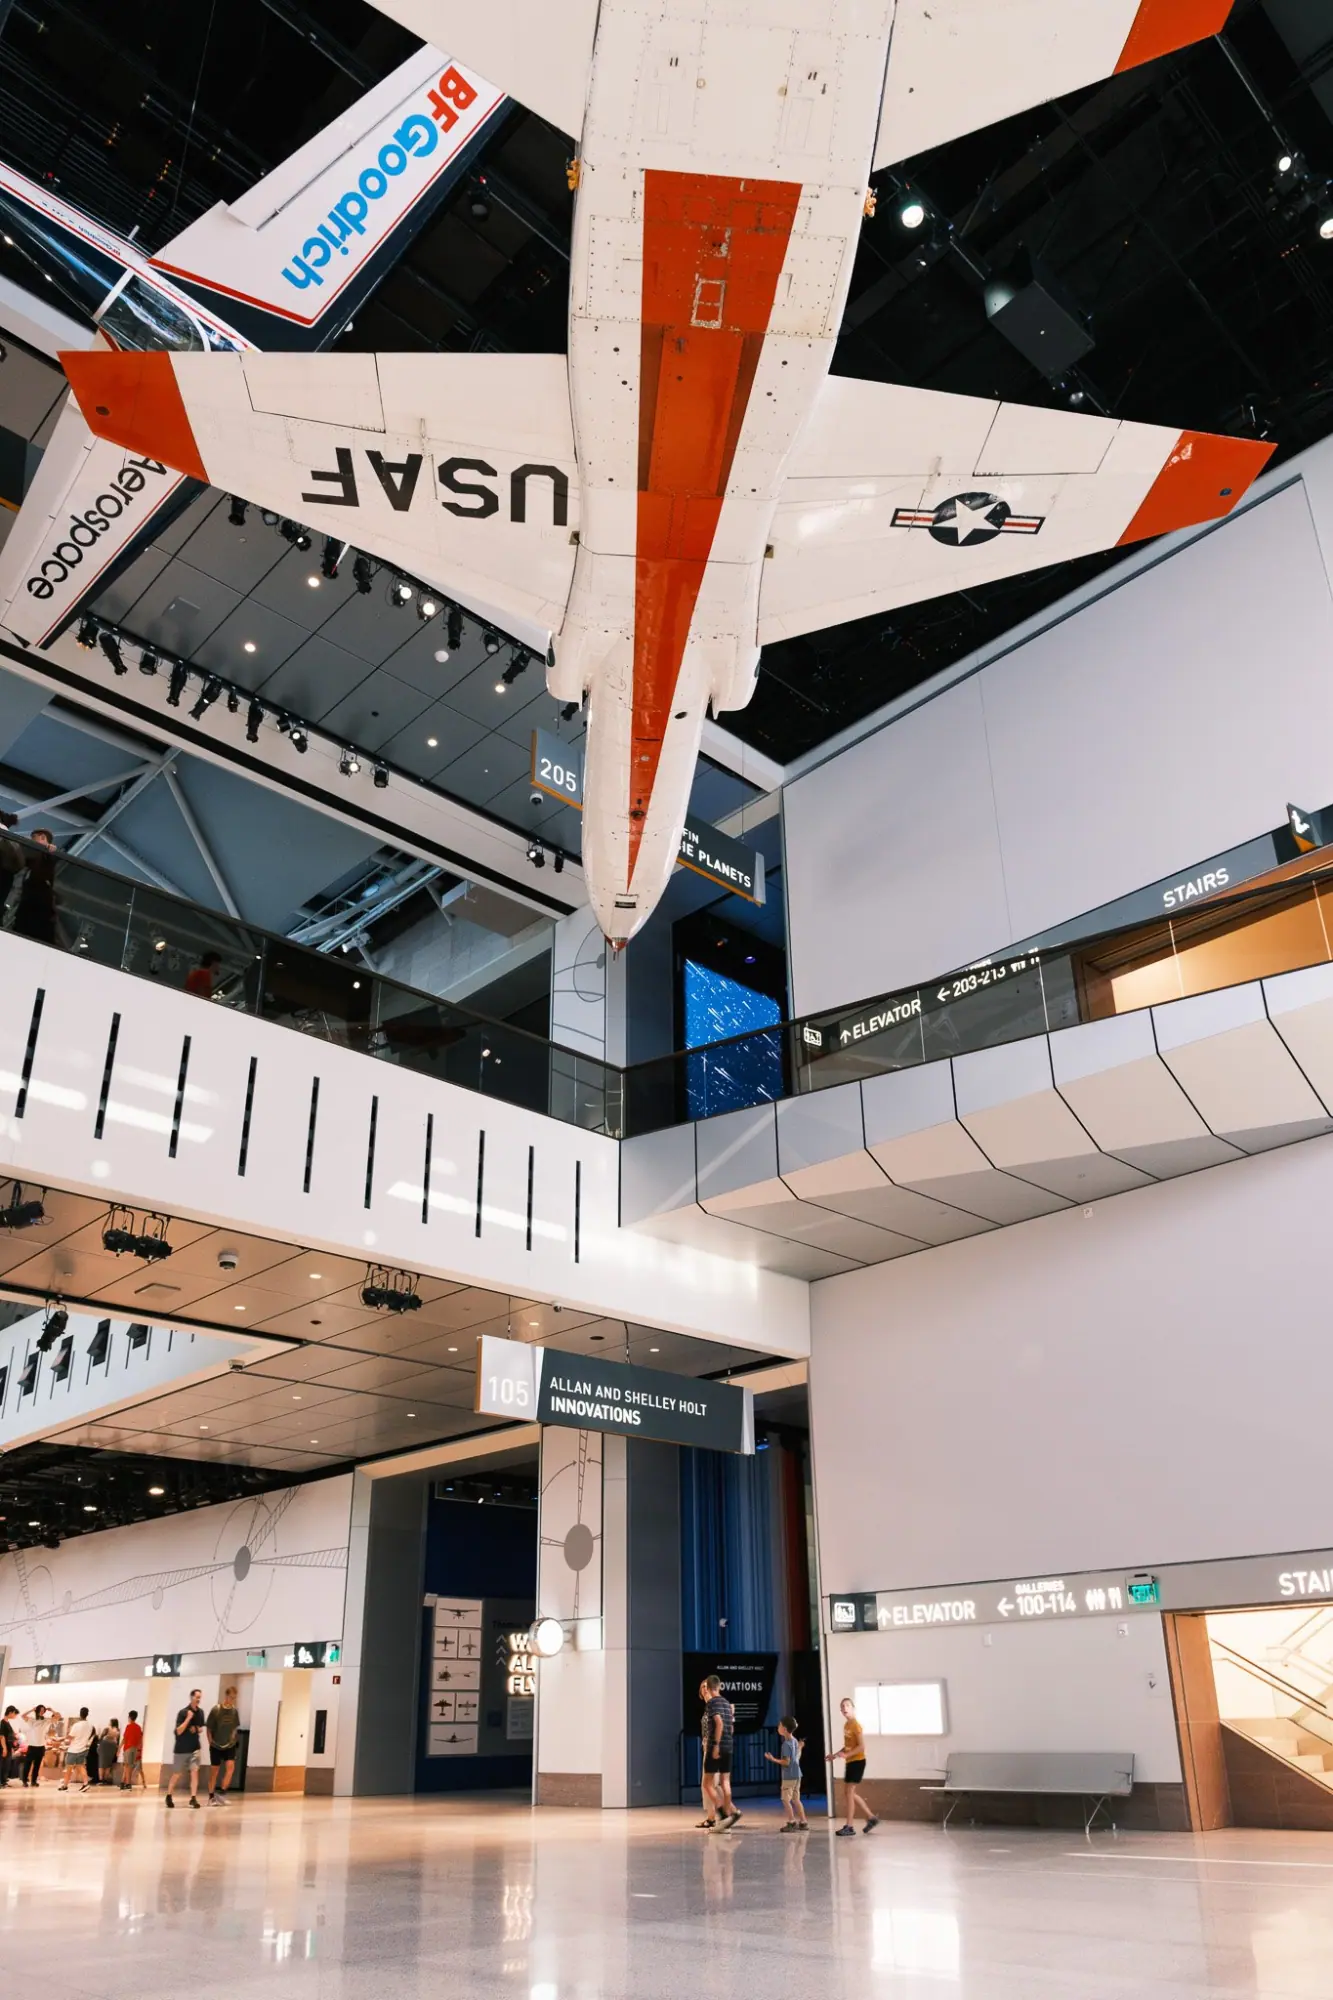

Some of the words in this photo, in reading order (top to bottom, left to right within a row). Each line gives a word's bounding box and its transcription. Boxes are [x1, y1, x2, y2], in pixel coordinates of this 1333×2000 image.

[281, 65, 478, 289] BFGoodrich
[301, 447, 569, 527] USAF
[540, 758, 577, 792] 205
[680, 841, 694, 857] HE
[698, 850, 751, 888] PLANETS
[1163, 868, 1229, 908] STAIRS
[852, 998, 921, 1040] ELEVATOR
[488, 1376, 529, 1407] 105
[550, 1376, 592, 1396] ALLAN
[595, 1385, 621, 1402] AND
[624, 1390, 677, 1412] SHELLEY
[679, 1401, 707, 1417] HOLT
[550, 1396, 642, 1426] INNOVATIONS
[1015, 1579, 1065, 1595] GALLERIES
[1279, 1569, 1333, 1596] STAI
[892, 1600, 976, 1626] ELEVATOR
[1016, 1592, 1077, 1616] 100-114
[719, 1682, 763, 1691] OVATIONS
